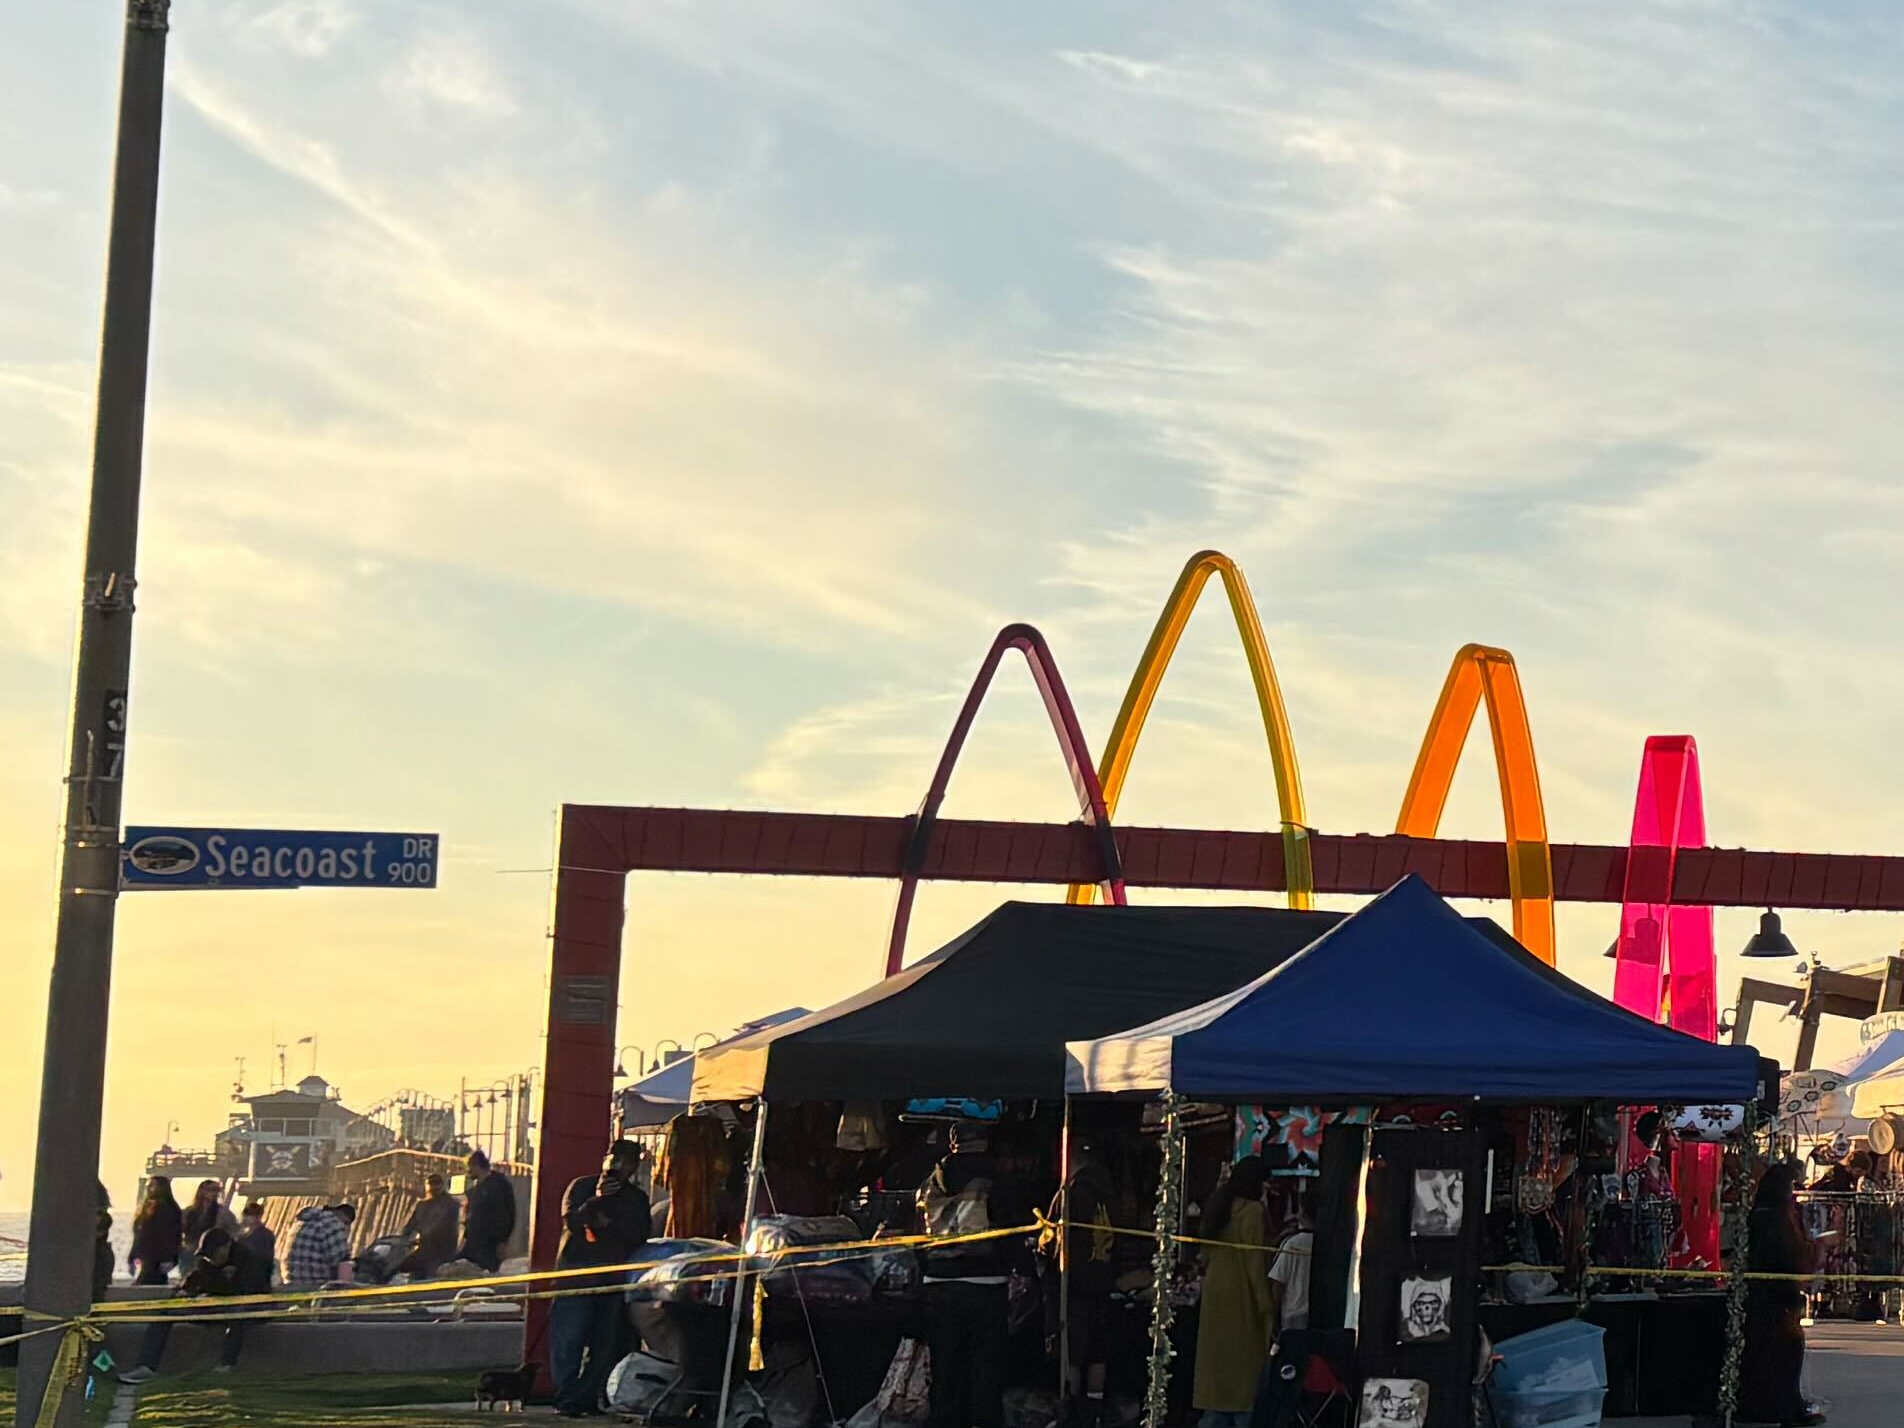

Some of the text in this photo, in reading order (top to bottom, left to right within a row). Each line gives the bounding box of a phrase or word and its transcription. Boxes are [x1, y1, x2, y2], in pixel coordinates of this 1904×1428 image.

[205, 836, 432, 879] Seacoast DR
[388, 863, 432, 883] 900
